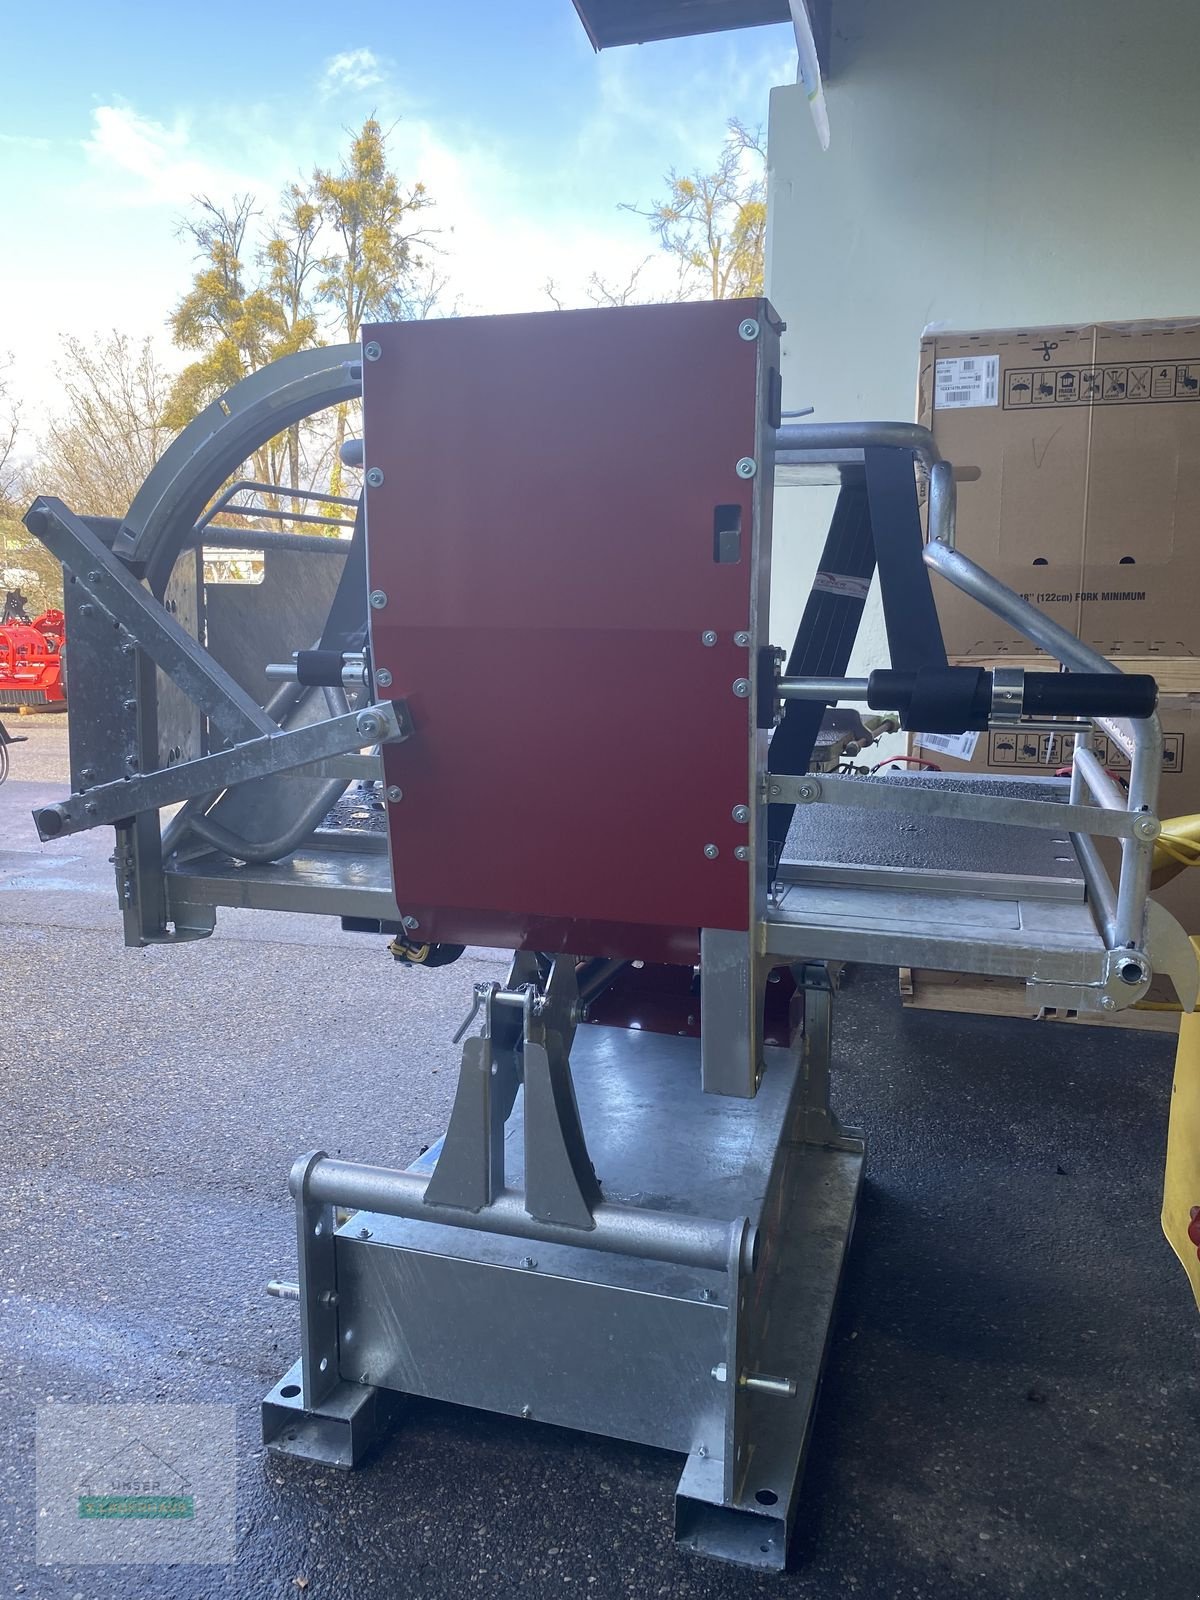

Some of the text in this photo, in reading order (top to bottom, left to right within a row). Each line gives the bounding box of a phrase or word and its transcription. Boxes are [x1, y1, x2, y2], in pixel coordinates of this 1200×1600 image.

[1160, 368, 1168, 378] 4
[1037, 592, 1072, 603] (122cm)
[1075, 592, 1098, 601] FORK
[1101, 591, 1146, 601] MINIMUM
